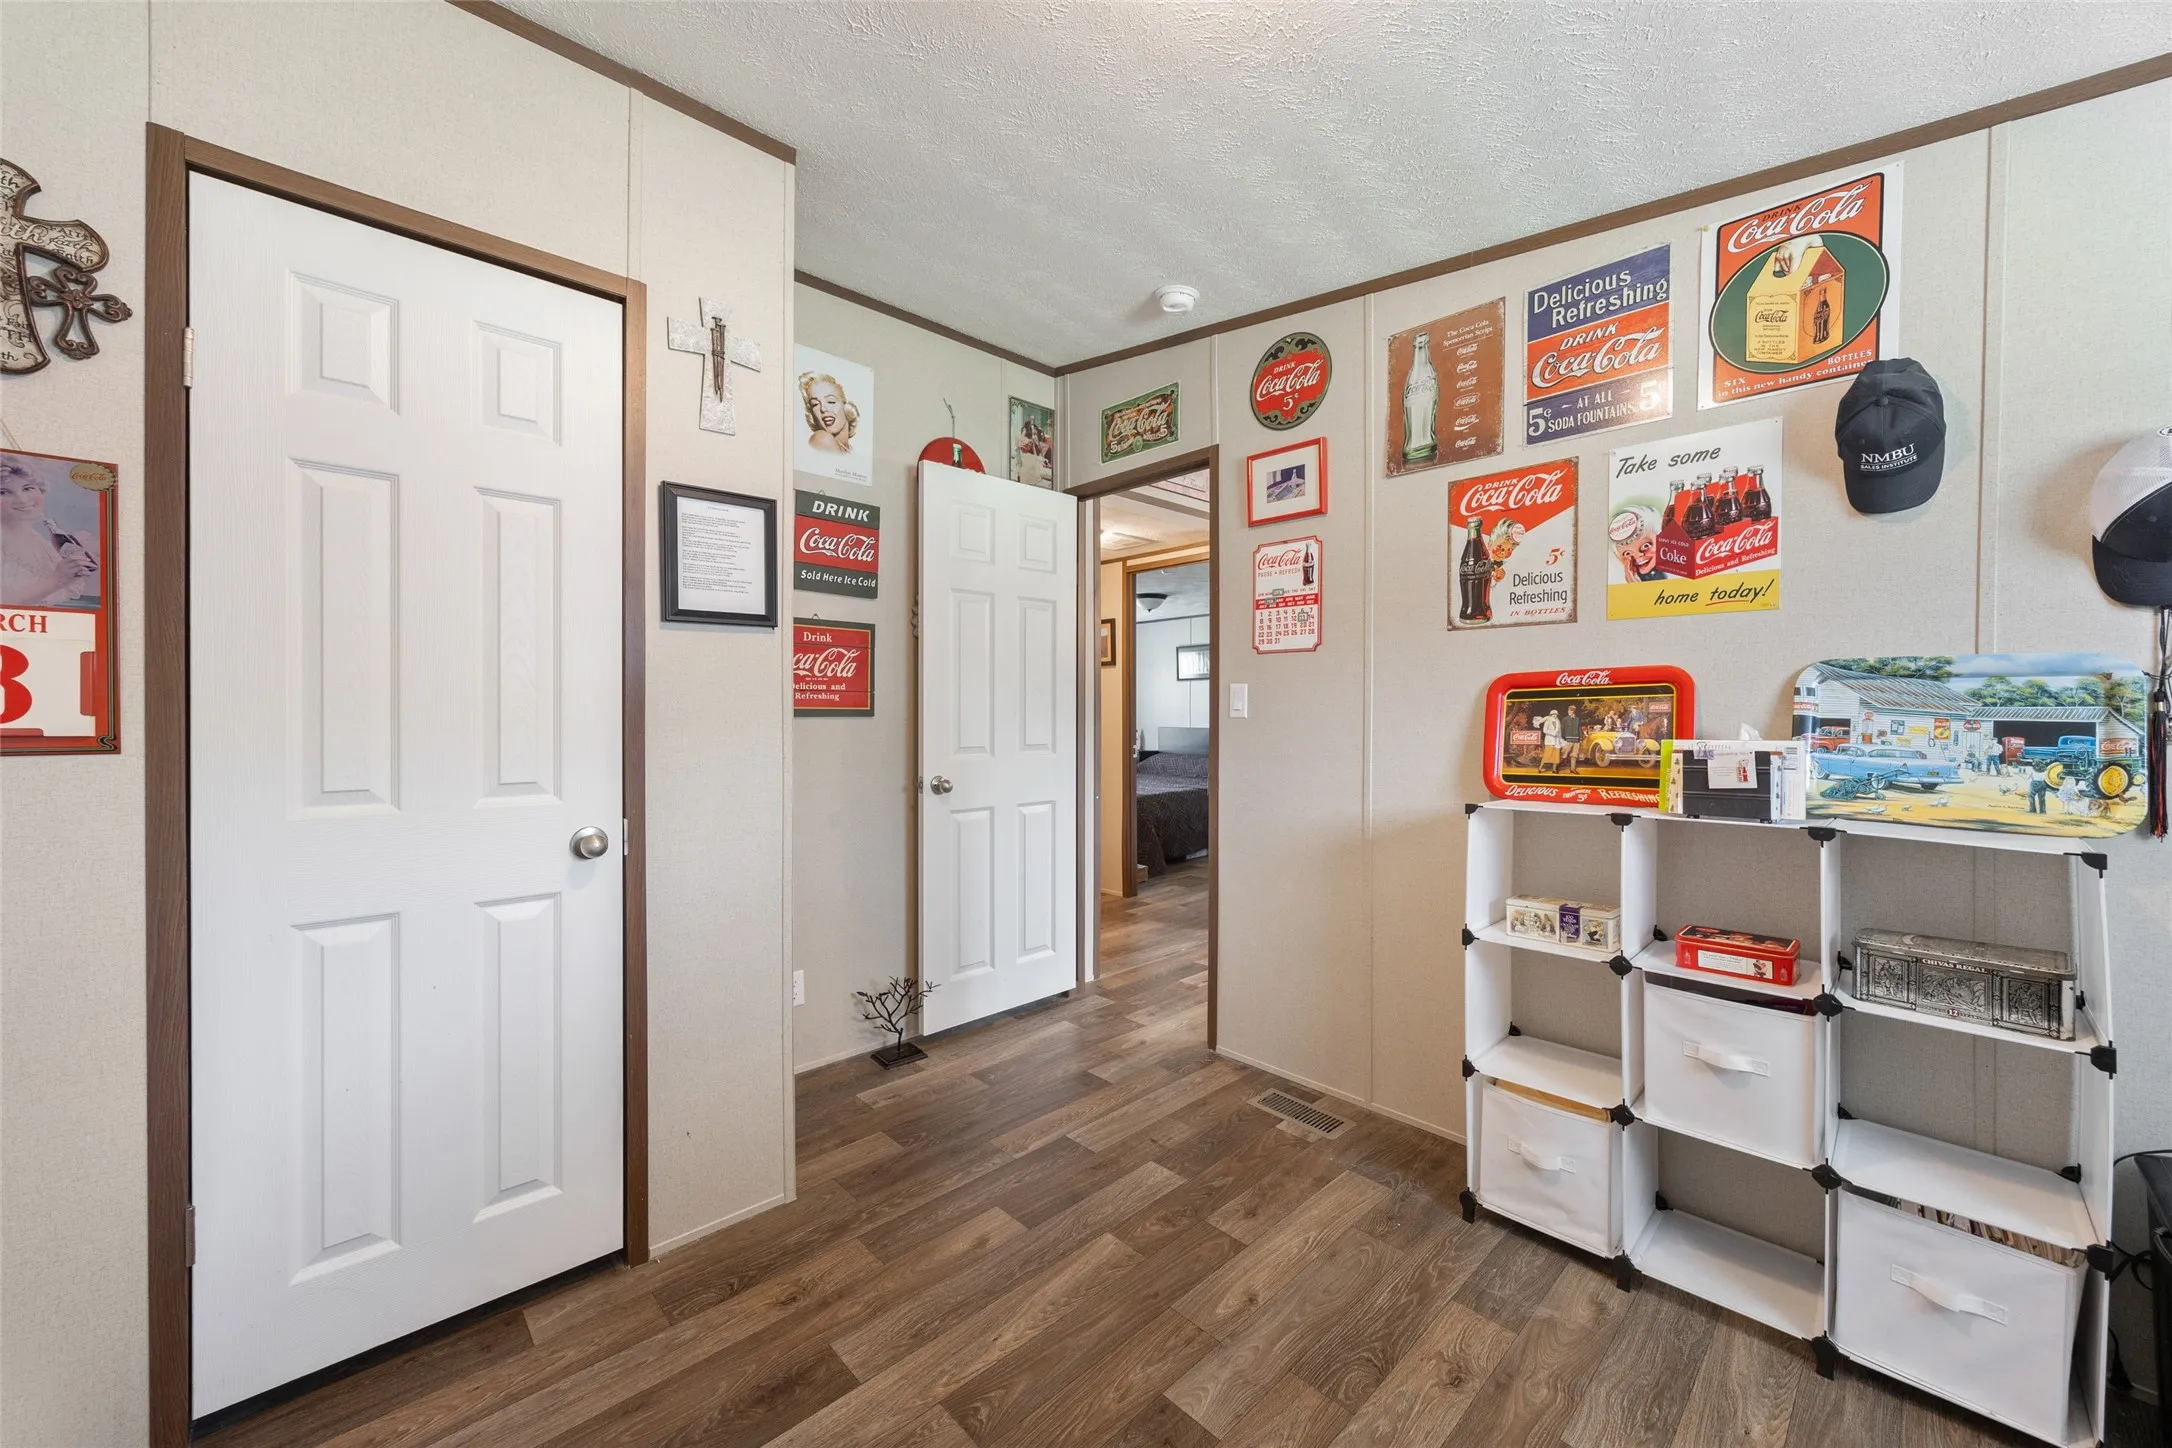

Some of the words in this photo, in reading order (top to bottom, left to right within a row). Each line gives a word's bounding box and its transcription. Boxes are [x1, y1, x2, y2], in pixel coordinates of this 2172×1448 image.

[1728, 180, 1873, 253] Coca-Cola
[1763, 203, 1803, 222] DRINK
[1534, 270, 1632, 314] Delicious
[1552, 278, 1668, 328] Refreshing
[1560, 322, 1619, 350] DRINK
[1274, 361, 1296, 374] DRINK
[1532, 326, 1665, 388] Coca-Cola
[1827, 349, 1873, 365] BOTTLES
[1256, 359, 1324, 401] Coca-Cola
[1724, 377, 1746, 388] SIX
[1732, 385, 1750, 395] this
[1754, 380, 1775, 389] new
[1779, 373, 1812, 384] handy
[1577, 395, 1590, 409] AT
[1594, 390, 1613, 404] ALL
[1528, 408, 1551, 436] 5¢
[1548, 417, 1575, 433] SODA
[1578, 402, 1637, 426] FOUNTAINS
[1616, 454, 1657, 479] Take
[1668, 447, 1721, 468] some
[1861, 443, 1914, 463] NMBU
[1881, 455, 1918, 469] INSTITUTE
[1460, 468, 1568, 516] Coca-Cola
[1484, 477, 1519, 490] DRINK
[812, 500, 870, 522] DRINK
[800, 528, 876, 562] Coca-Cola
[1696, 520, 1776, 564] Coca-Cola
[1258, 548, 1303, 570] Coca-Cola
[1660, 547, 1687, 564] Coke
[1696, 564, 1724, 576] Delicious
[1727, 558, 1739, 566] and
[1742, 548, 1776, 562] Refreshing
[801, 570, 821, 580] Sold
[823, 573, 843, 583] Here
[844, 576, 857, 585] Ice
[858, 577, 876, 587] Cold
[1513, 572, 1564, 588] Delicious
[1509, 589, 1568, 605] Refreshing
[1654, 589, 1699, 606] home
[1710, 578, 1775, 603] today!
[1524, 607, 1566, 617] BOTTLES
[803, 632, 832, 642] Drink
[793, 648, 860, 678] ca-Cola
[1556, 670, 1611, 686] Coca-Cola
[795, 692, 840, 702] Refreshing
[1505, 785, 1559, 797] DELICIOUS
[1922, 959, 1954, 968] CHIVAS
[1956, 964, 1987, 973] REGAL
